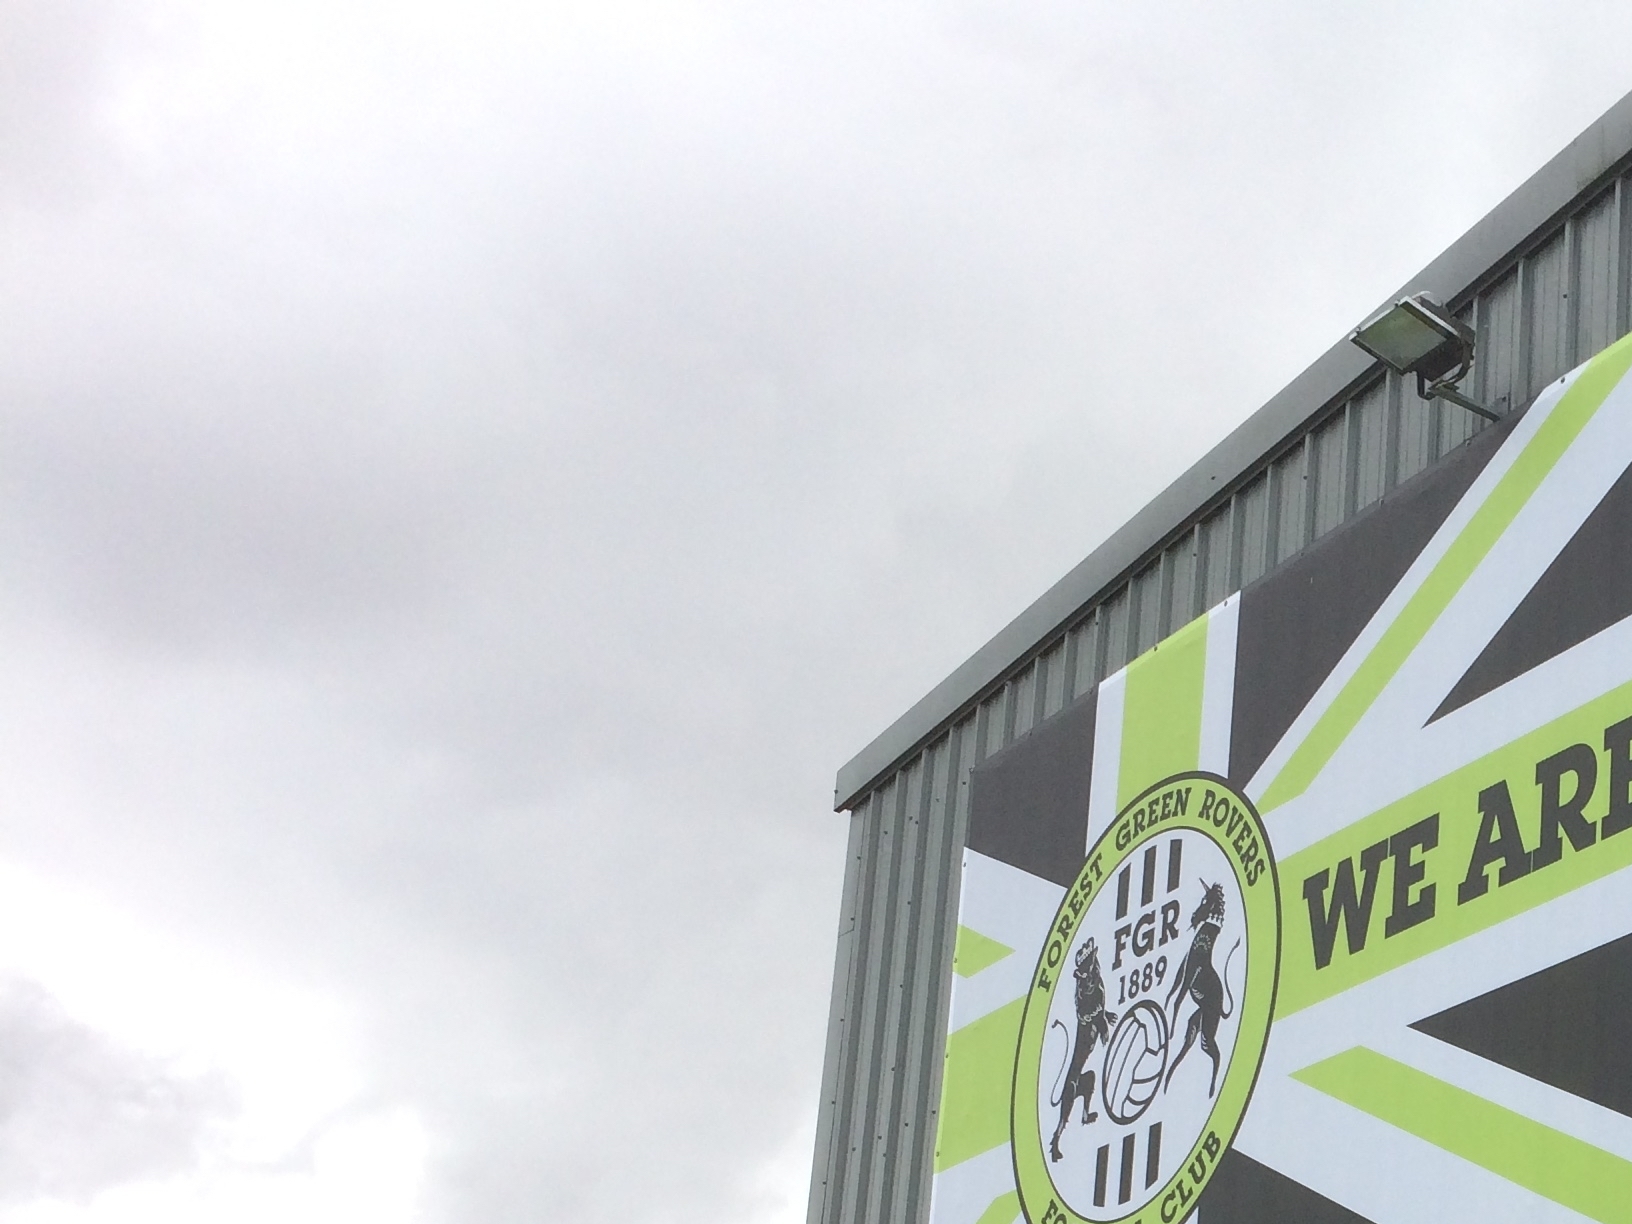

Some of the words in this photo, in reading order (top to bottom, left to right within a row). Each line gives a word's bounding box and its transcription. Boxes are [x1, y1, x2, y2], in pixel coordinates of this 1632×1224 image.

[1039, 854, 1103, 992] FOREST
[1116, 787, 1192, 853] GREEN
[1199, 790, 1265, 888] ROVERS
[1112, 899, 1180, 970] FGR
[1302, 813, 1440, 970] WE
[1118, 955, 1167, 1006] 1889
[1161, 1130, 1222, 1224] CLUB
